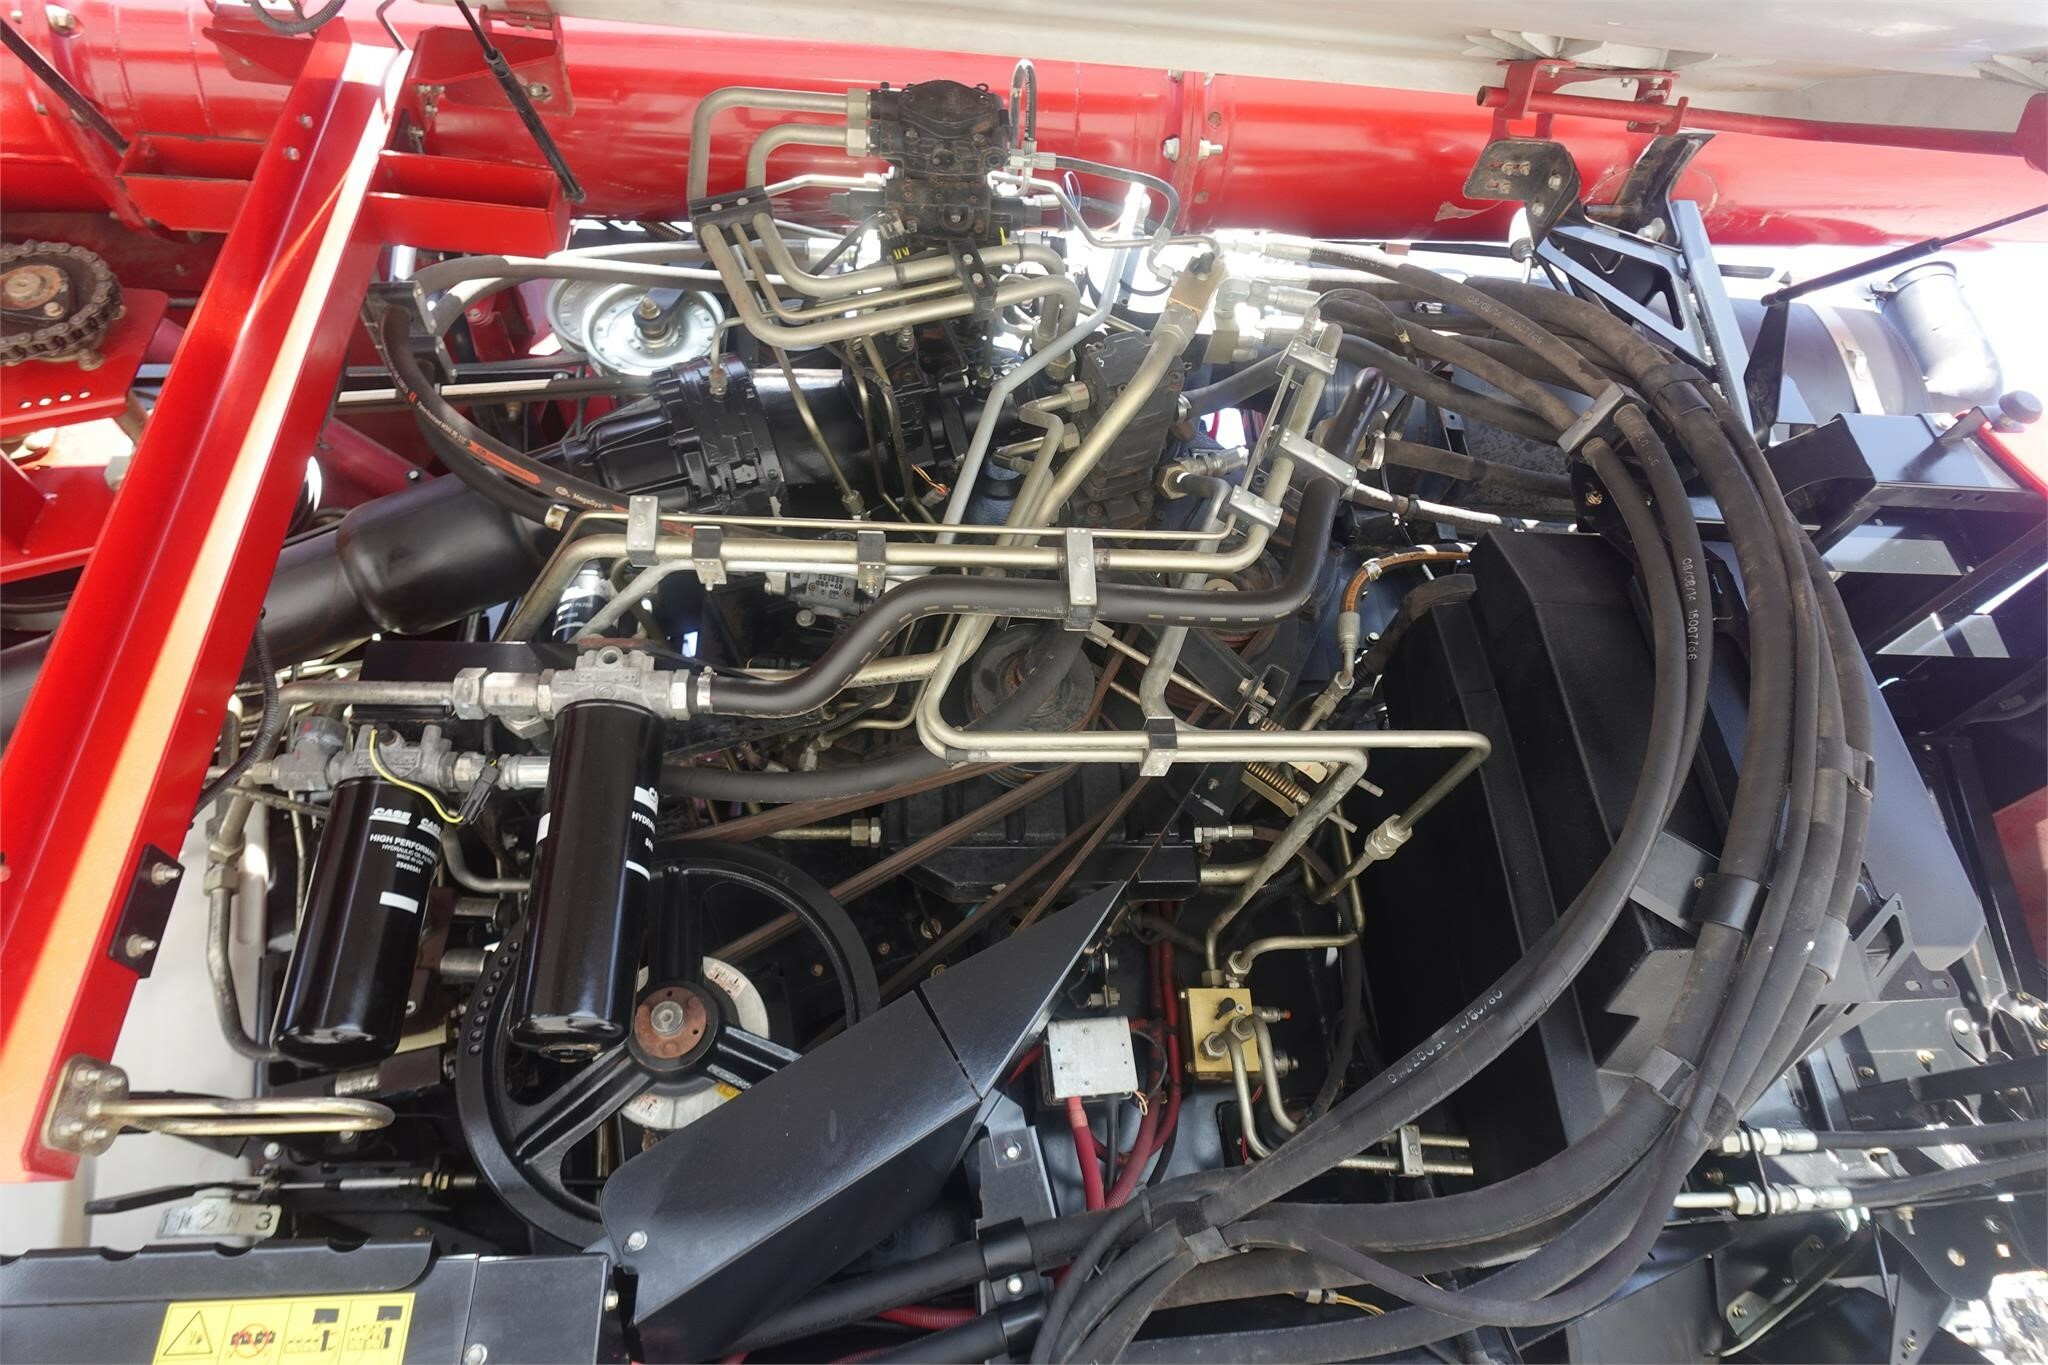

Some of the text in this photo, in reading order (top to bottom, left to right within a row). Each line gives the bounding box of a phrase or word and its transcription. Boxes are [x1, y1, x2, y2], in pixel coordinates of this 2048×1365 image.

[373, 807, 412, 821] CASE
[369, 833, 394, 844] HIGH
[381, 844, 414, 856] HYDRAULIC
[255, 1211, 274, 1231] 3
